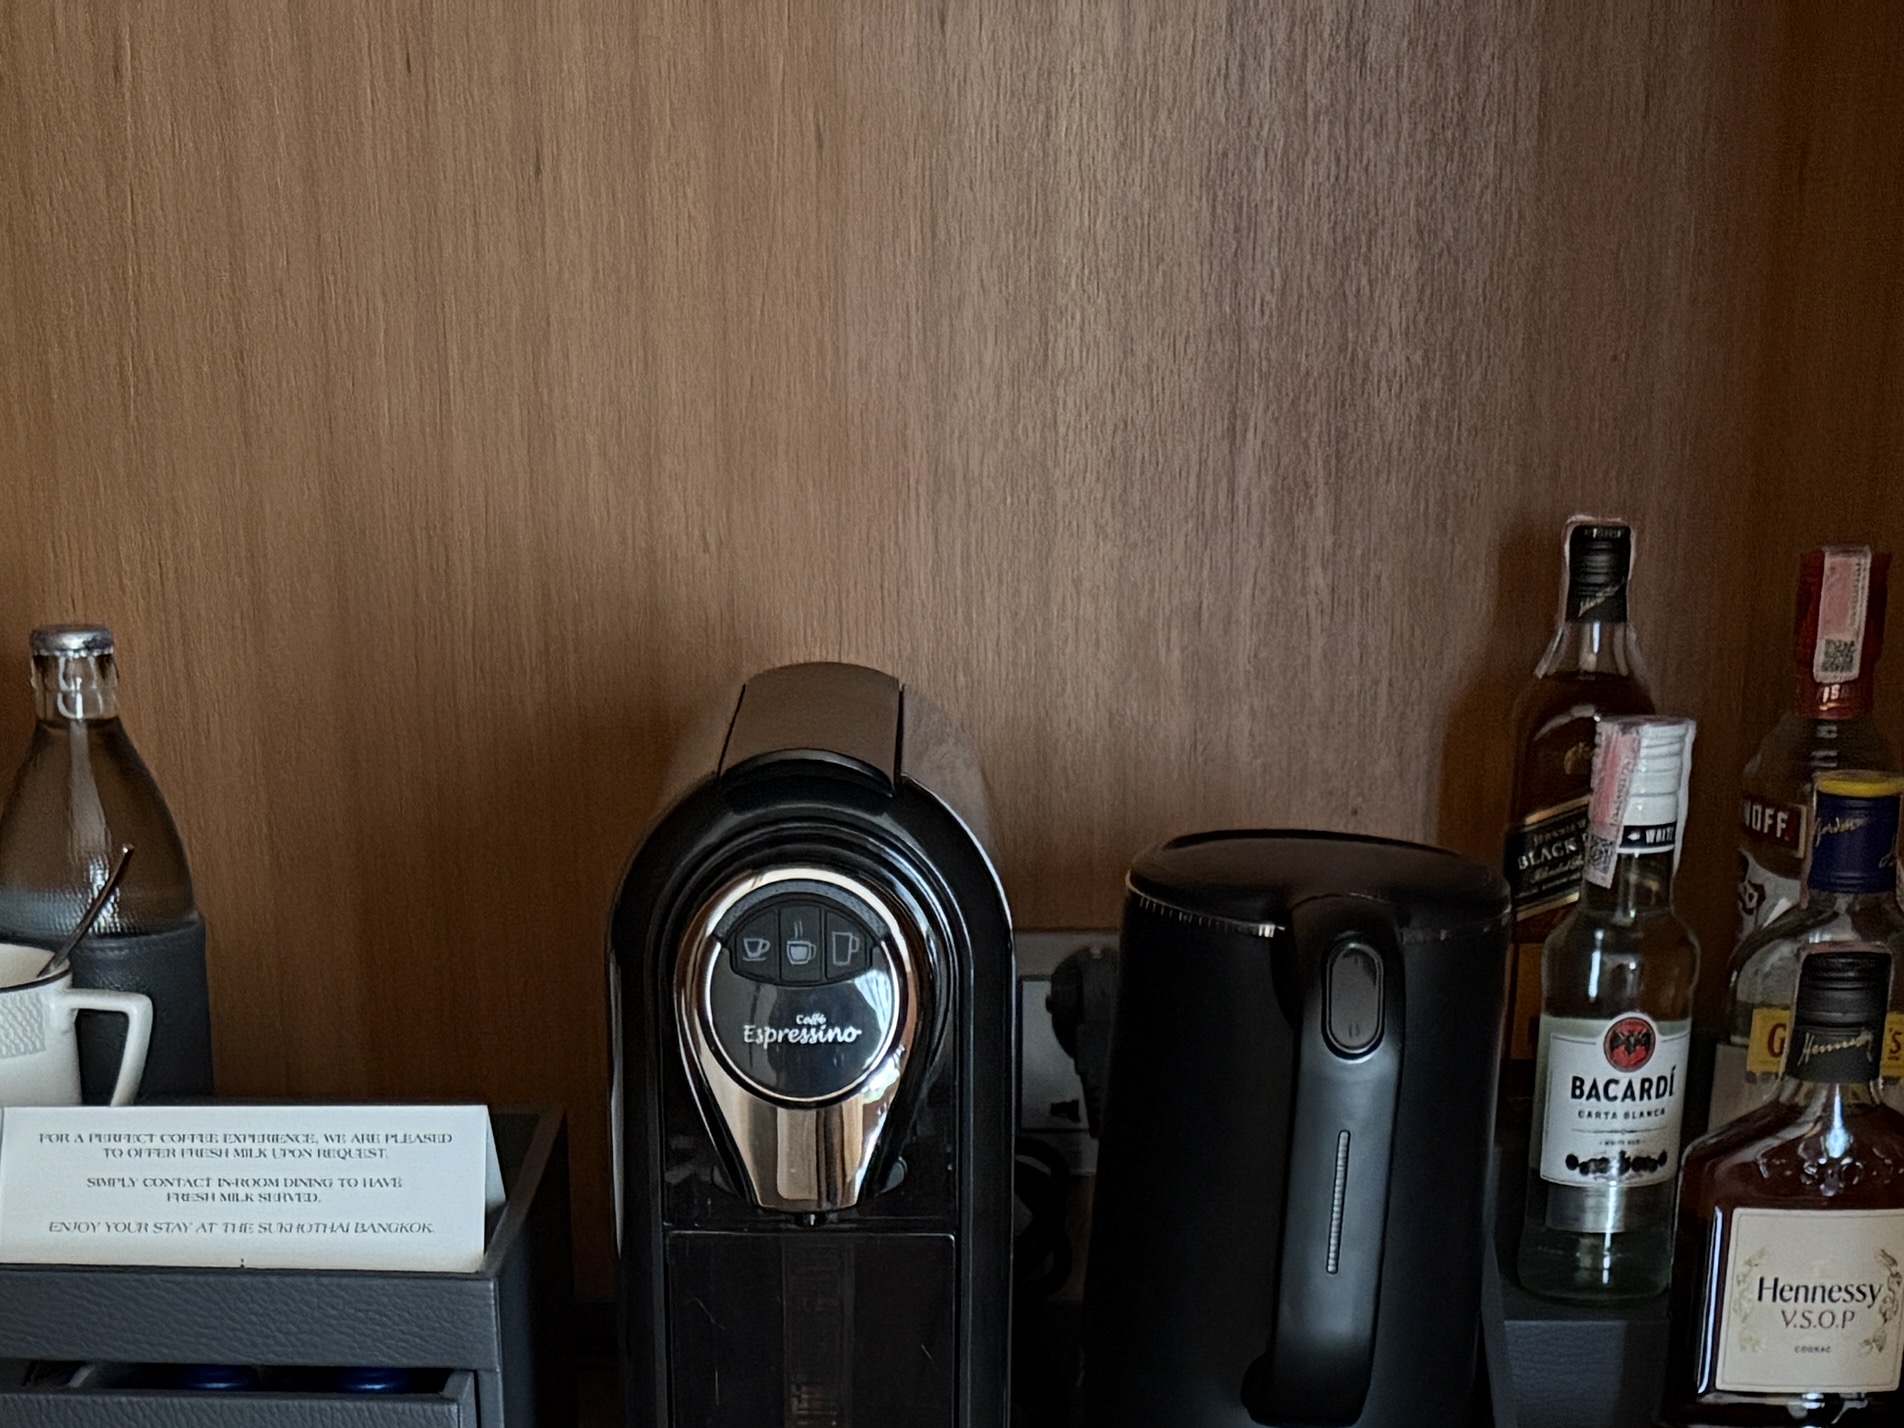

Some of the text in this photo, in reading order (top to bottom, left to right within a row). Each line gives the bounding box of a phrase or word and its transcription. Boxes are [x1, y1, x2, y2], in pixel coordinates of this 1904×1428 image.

[743, 1024, 863, 1050] Espressino
[1570, 1065, 1677, 1103] BACARDÍ
[1577, 1108, 1618, 1121] CARTA
[38, 1132, 453, 1145] FOR A PERFECT COFFEE EXPERIENCE, WE ARE PLEASED
[103, 1148, 388, 1159] TO OFFER FRESH MILK UPON REQUEST.
[86, 1177, 404, 1189] SIMPLY CONTACT IN-ROOM DINING TO HAVE
[166, 1192, 322, 1203] FRESH MILK SERVED.
[48, 1221, 436, 1235] ENJOY YOUR STAY AT THE SUKHOTHAI BANGKOK.
[1757, 1276, 1883, 1310] Hennessy
[1780, 1309, 1857, 1330] V.S.O.P
